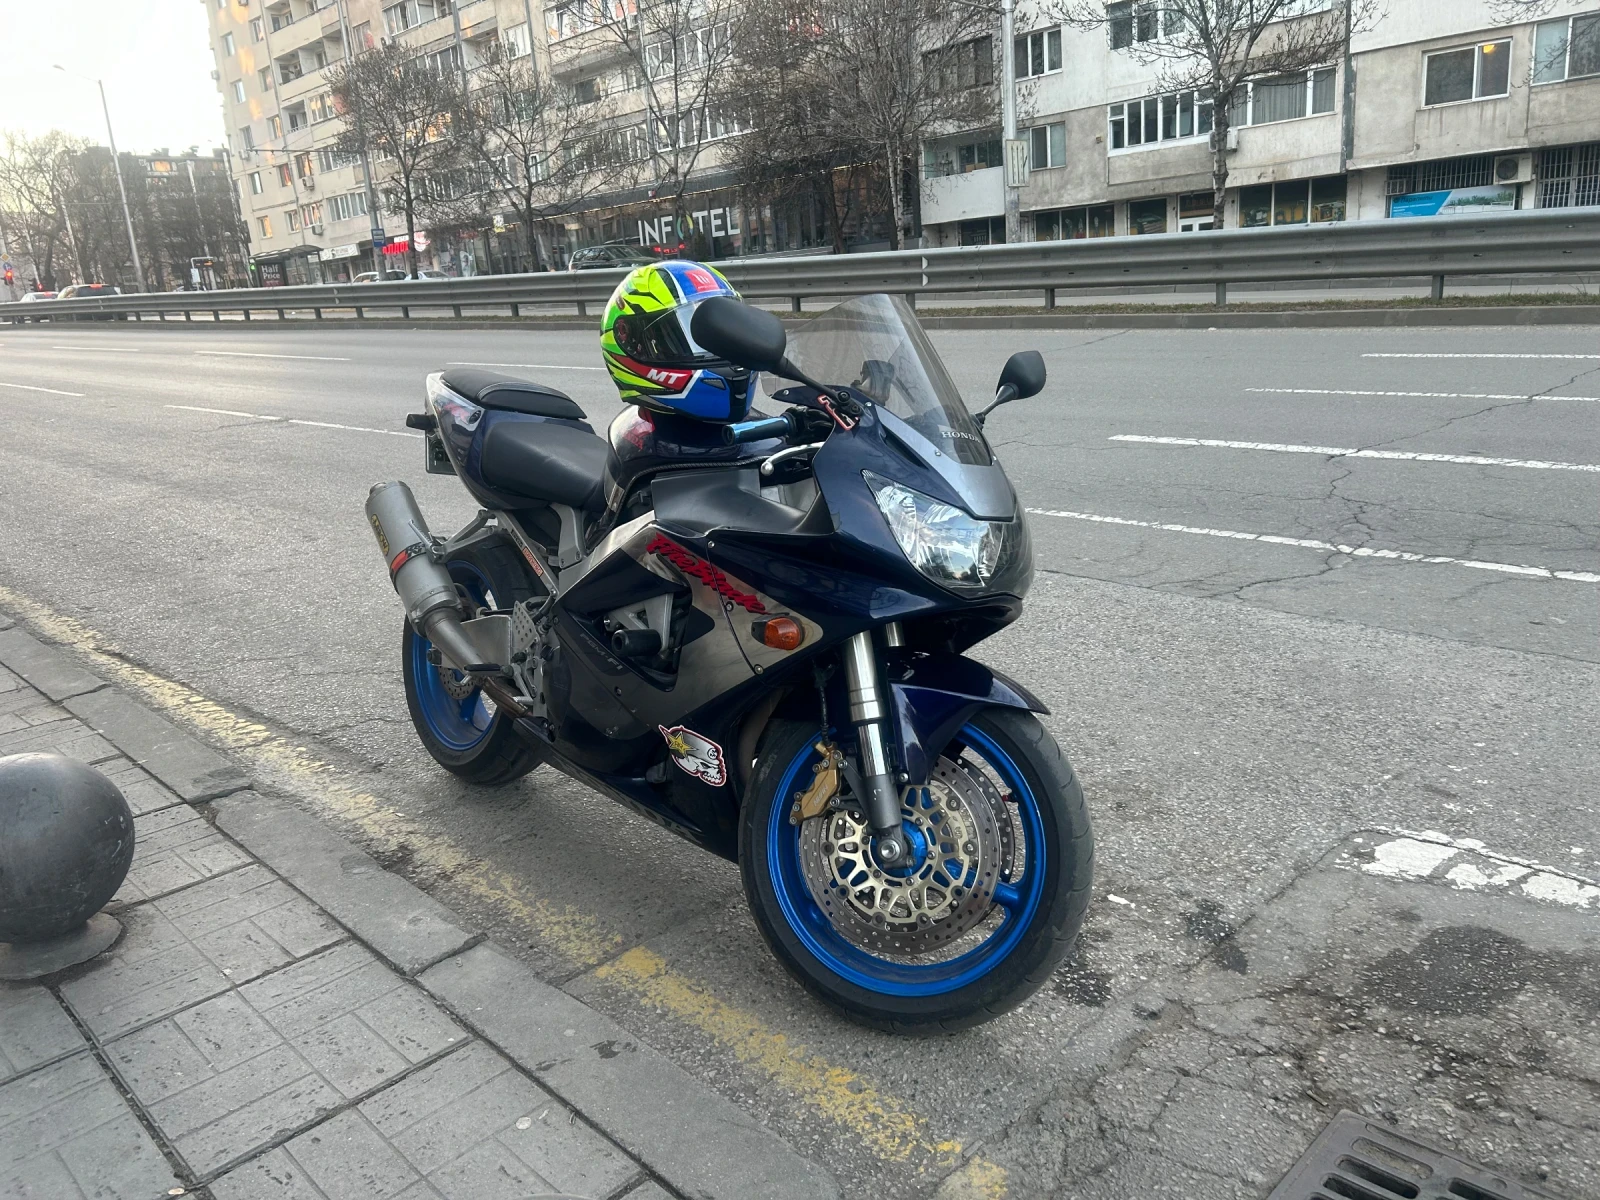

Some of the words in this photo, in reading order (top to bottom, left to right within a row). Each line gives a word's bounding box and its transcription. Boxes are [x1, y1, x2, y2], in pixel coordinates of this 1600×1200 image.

[261, 264, 279, 273] Half
[646, 368, 688, 385] MT
[580, 633, 623, 670] PGM-FI
